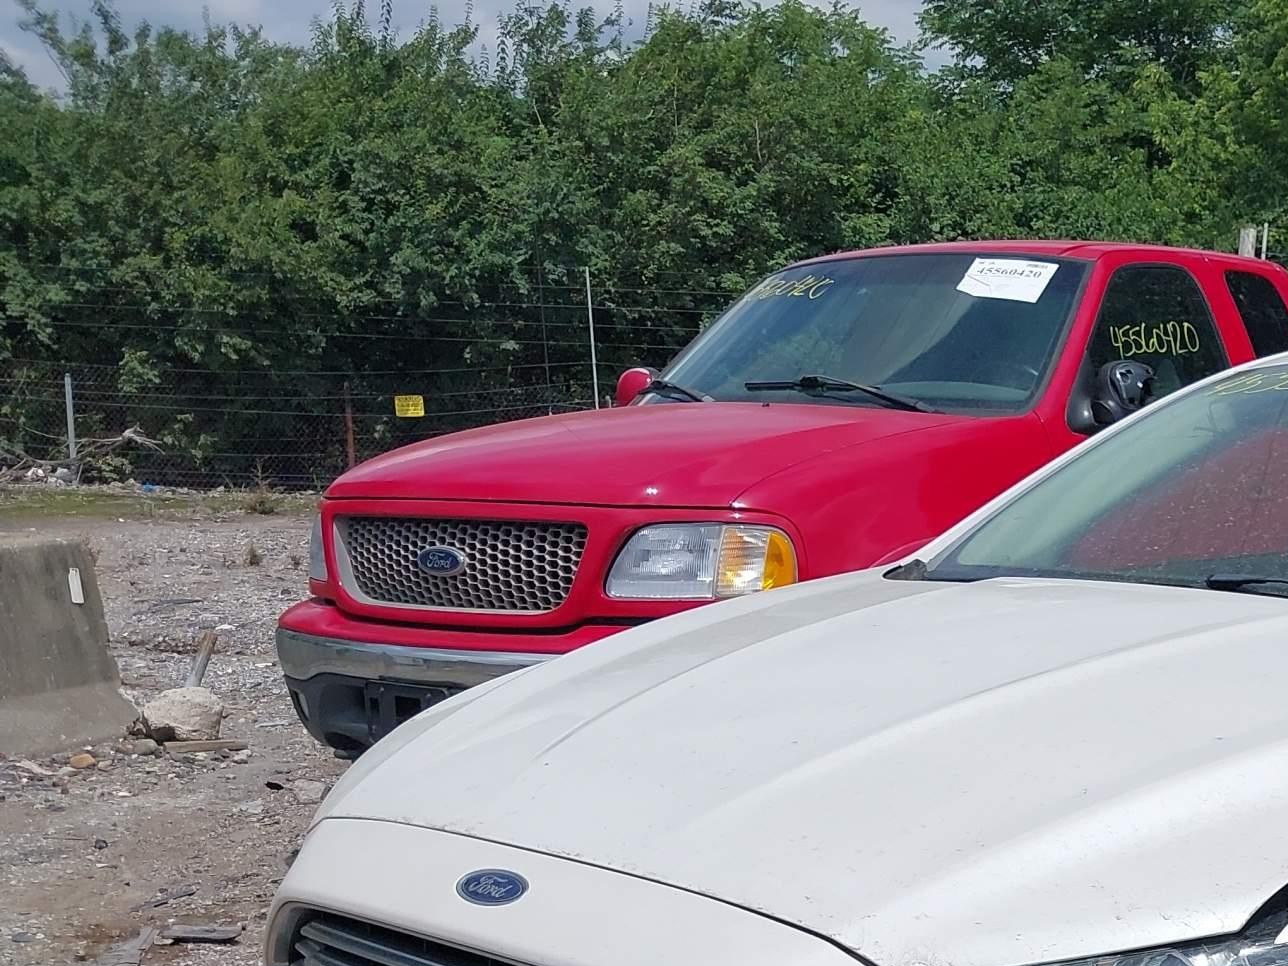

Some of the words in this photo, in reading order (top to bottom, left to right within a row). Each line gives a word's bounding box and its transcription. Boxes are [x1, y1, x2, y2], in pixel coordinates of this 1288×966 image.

[976, 266, 1042, 279] 45560420
[1109, 321, 1200, 360] 45560420
[426, 551, 453, 568] Ford
[468, 875, 513, 898] Ford
